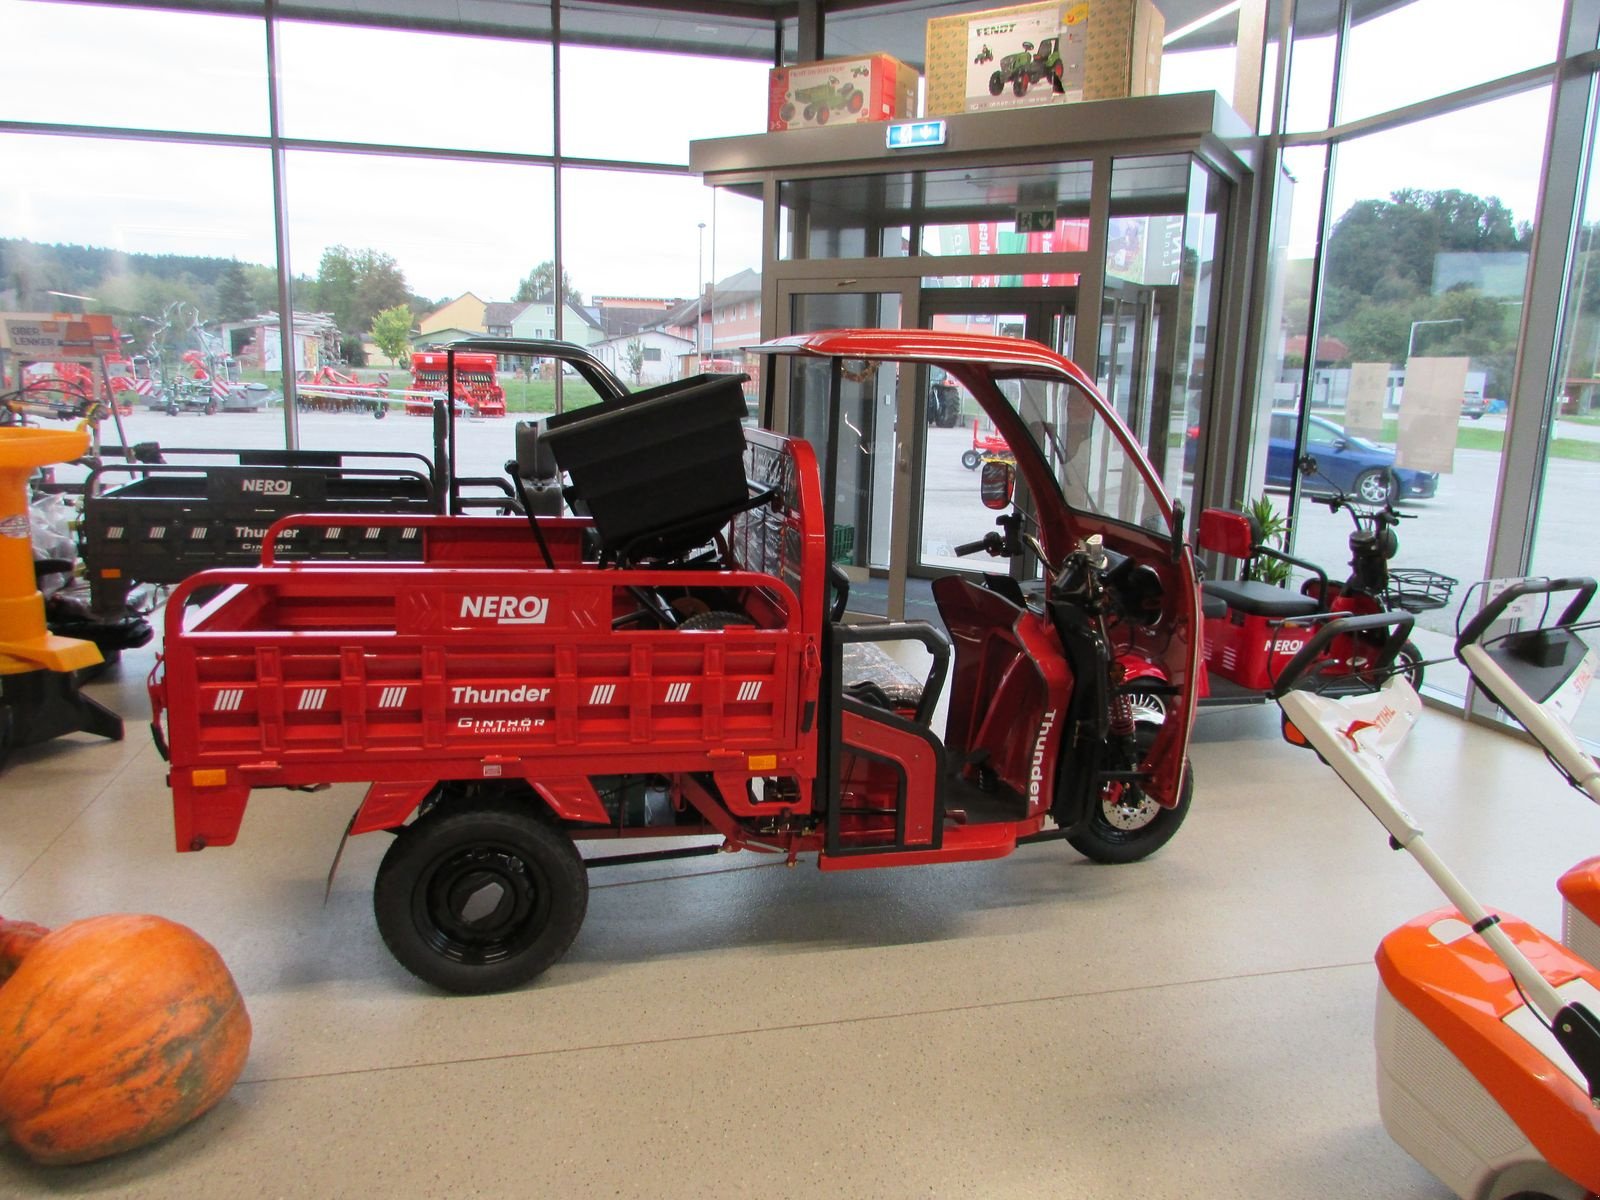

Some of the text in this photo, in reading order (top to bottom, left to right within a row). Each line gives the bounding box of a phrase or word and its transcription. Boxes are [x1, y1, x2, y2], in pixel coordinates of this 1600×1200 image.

[976, 23, 1016, 37] FENDT
[14, 338, 55, 346] LENKER
[242, 479, 292, 495] NERO
[235, 526, 299, 538] Thuer
[460, 596, 549, 624] NERO
[1264, 640, 1303, 655] NERO
[452, 685, 550, 704] Thunder
[1375, 705, 1396, 733] STIHL
[1030, 709, 1056, 805] Thunder
